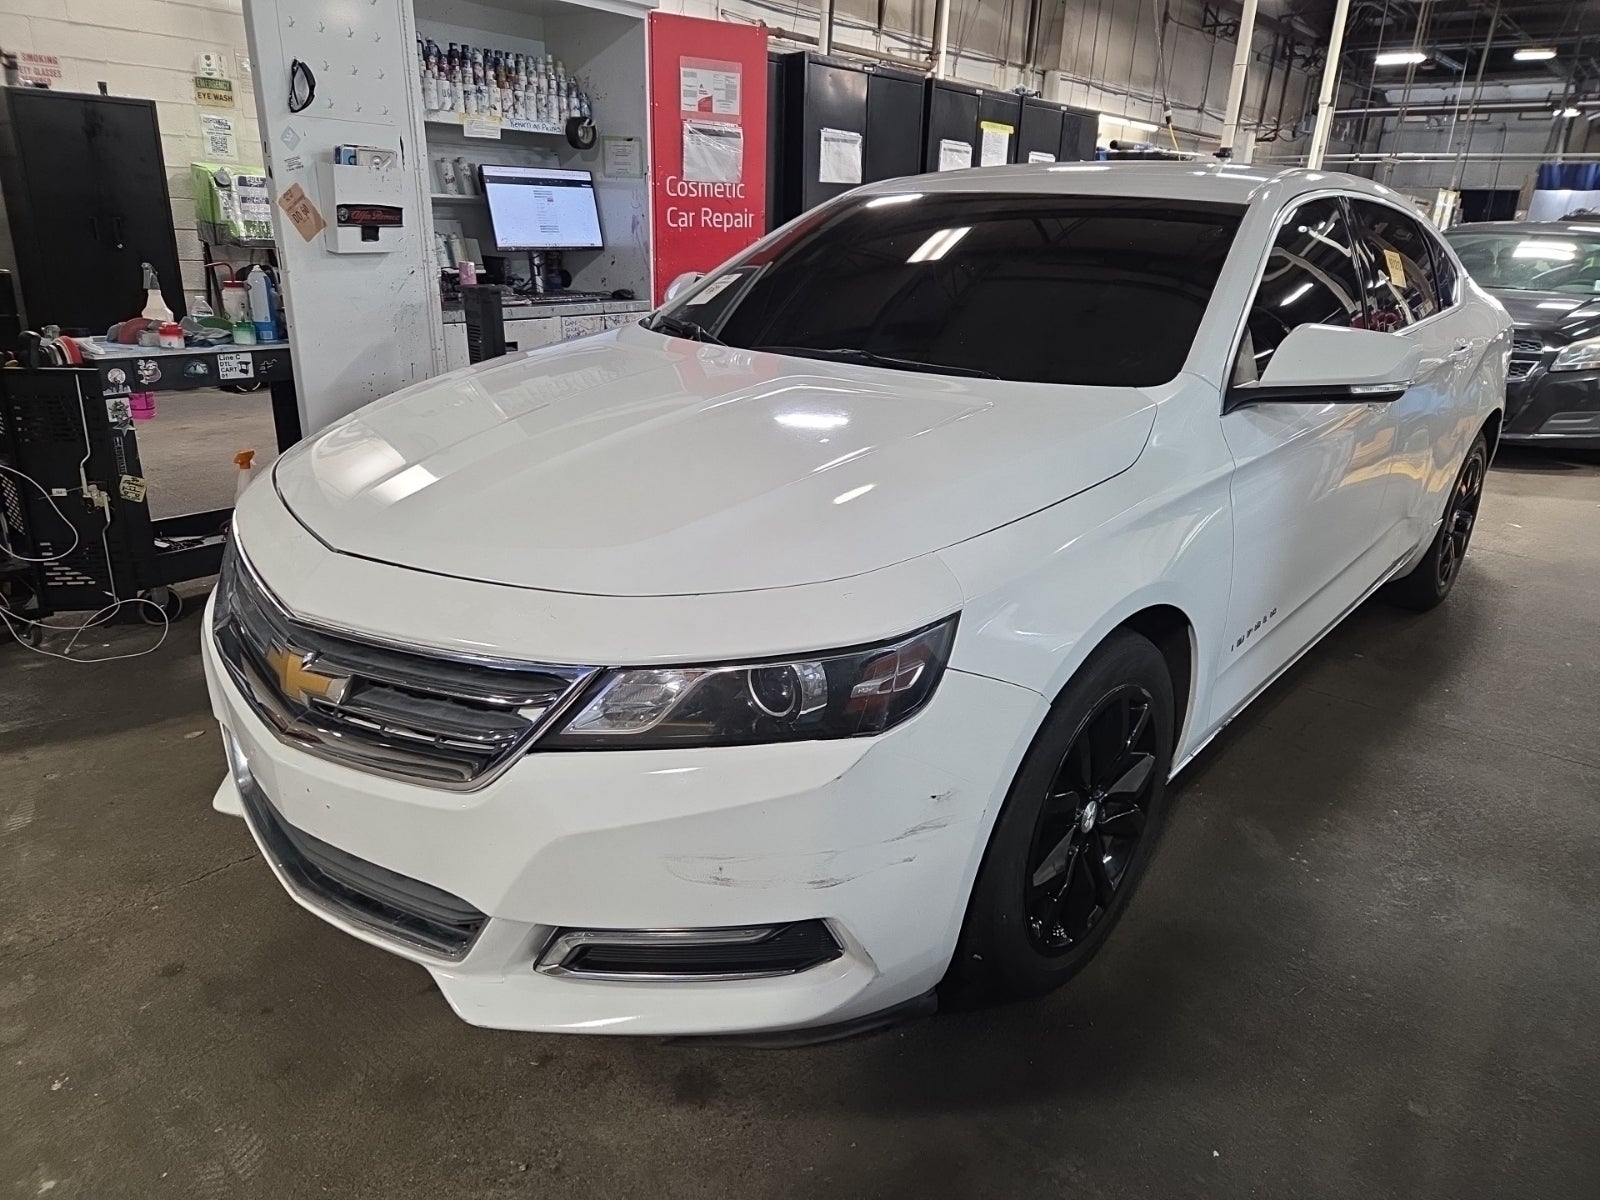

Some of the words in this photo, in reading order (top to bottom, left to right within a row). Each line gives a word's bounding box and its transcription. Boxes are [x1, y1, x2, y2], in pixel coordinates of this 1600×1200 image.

[21, 53, 58, 65] SMOKING
[33, 67, 62, 78] GLASSES
[196, 79, 231, 90] EMERGENCY
[197, 91, 212, 100] EYE
[213, 93, 233, 102] WASH
[666, 175, 745, 199] Cosmetic
[351, 210, 372, 223] Alfa
[666, 206, 696, 228] Car
[700, 207, 755, 232] Repair
